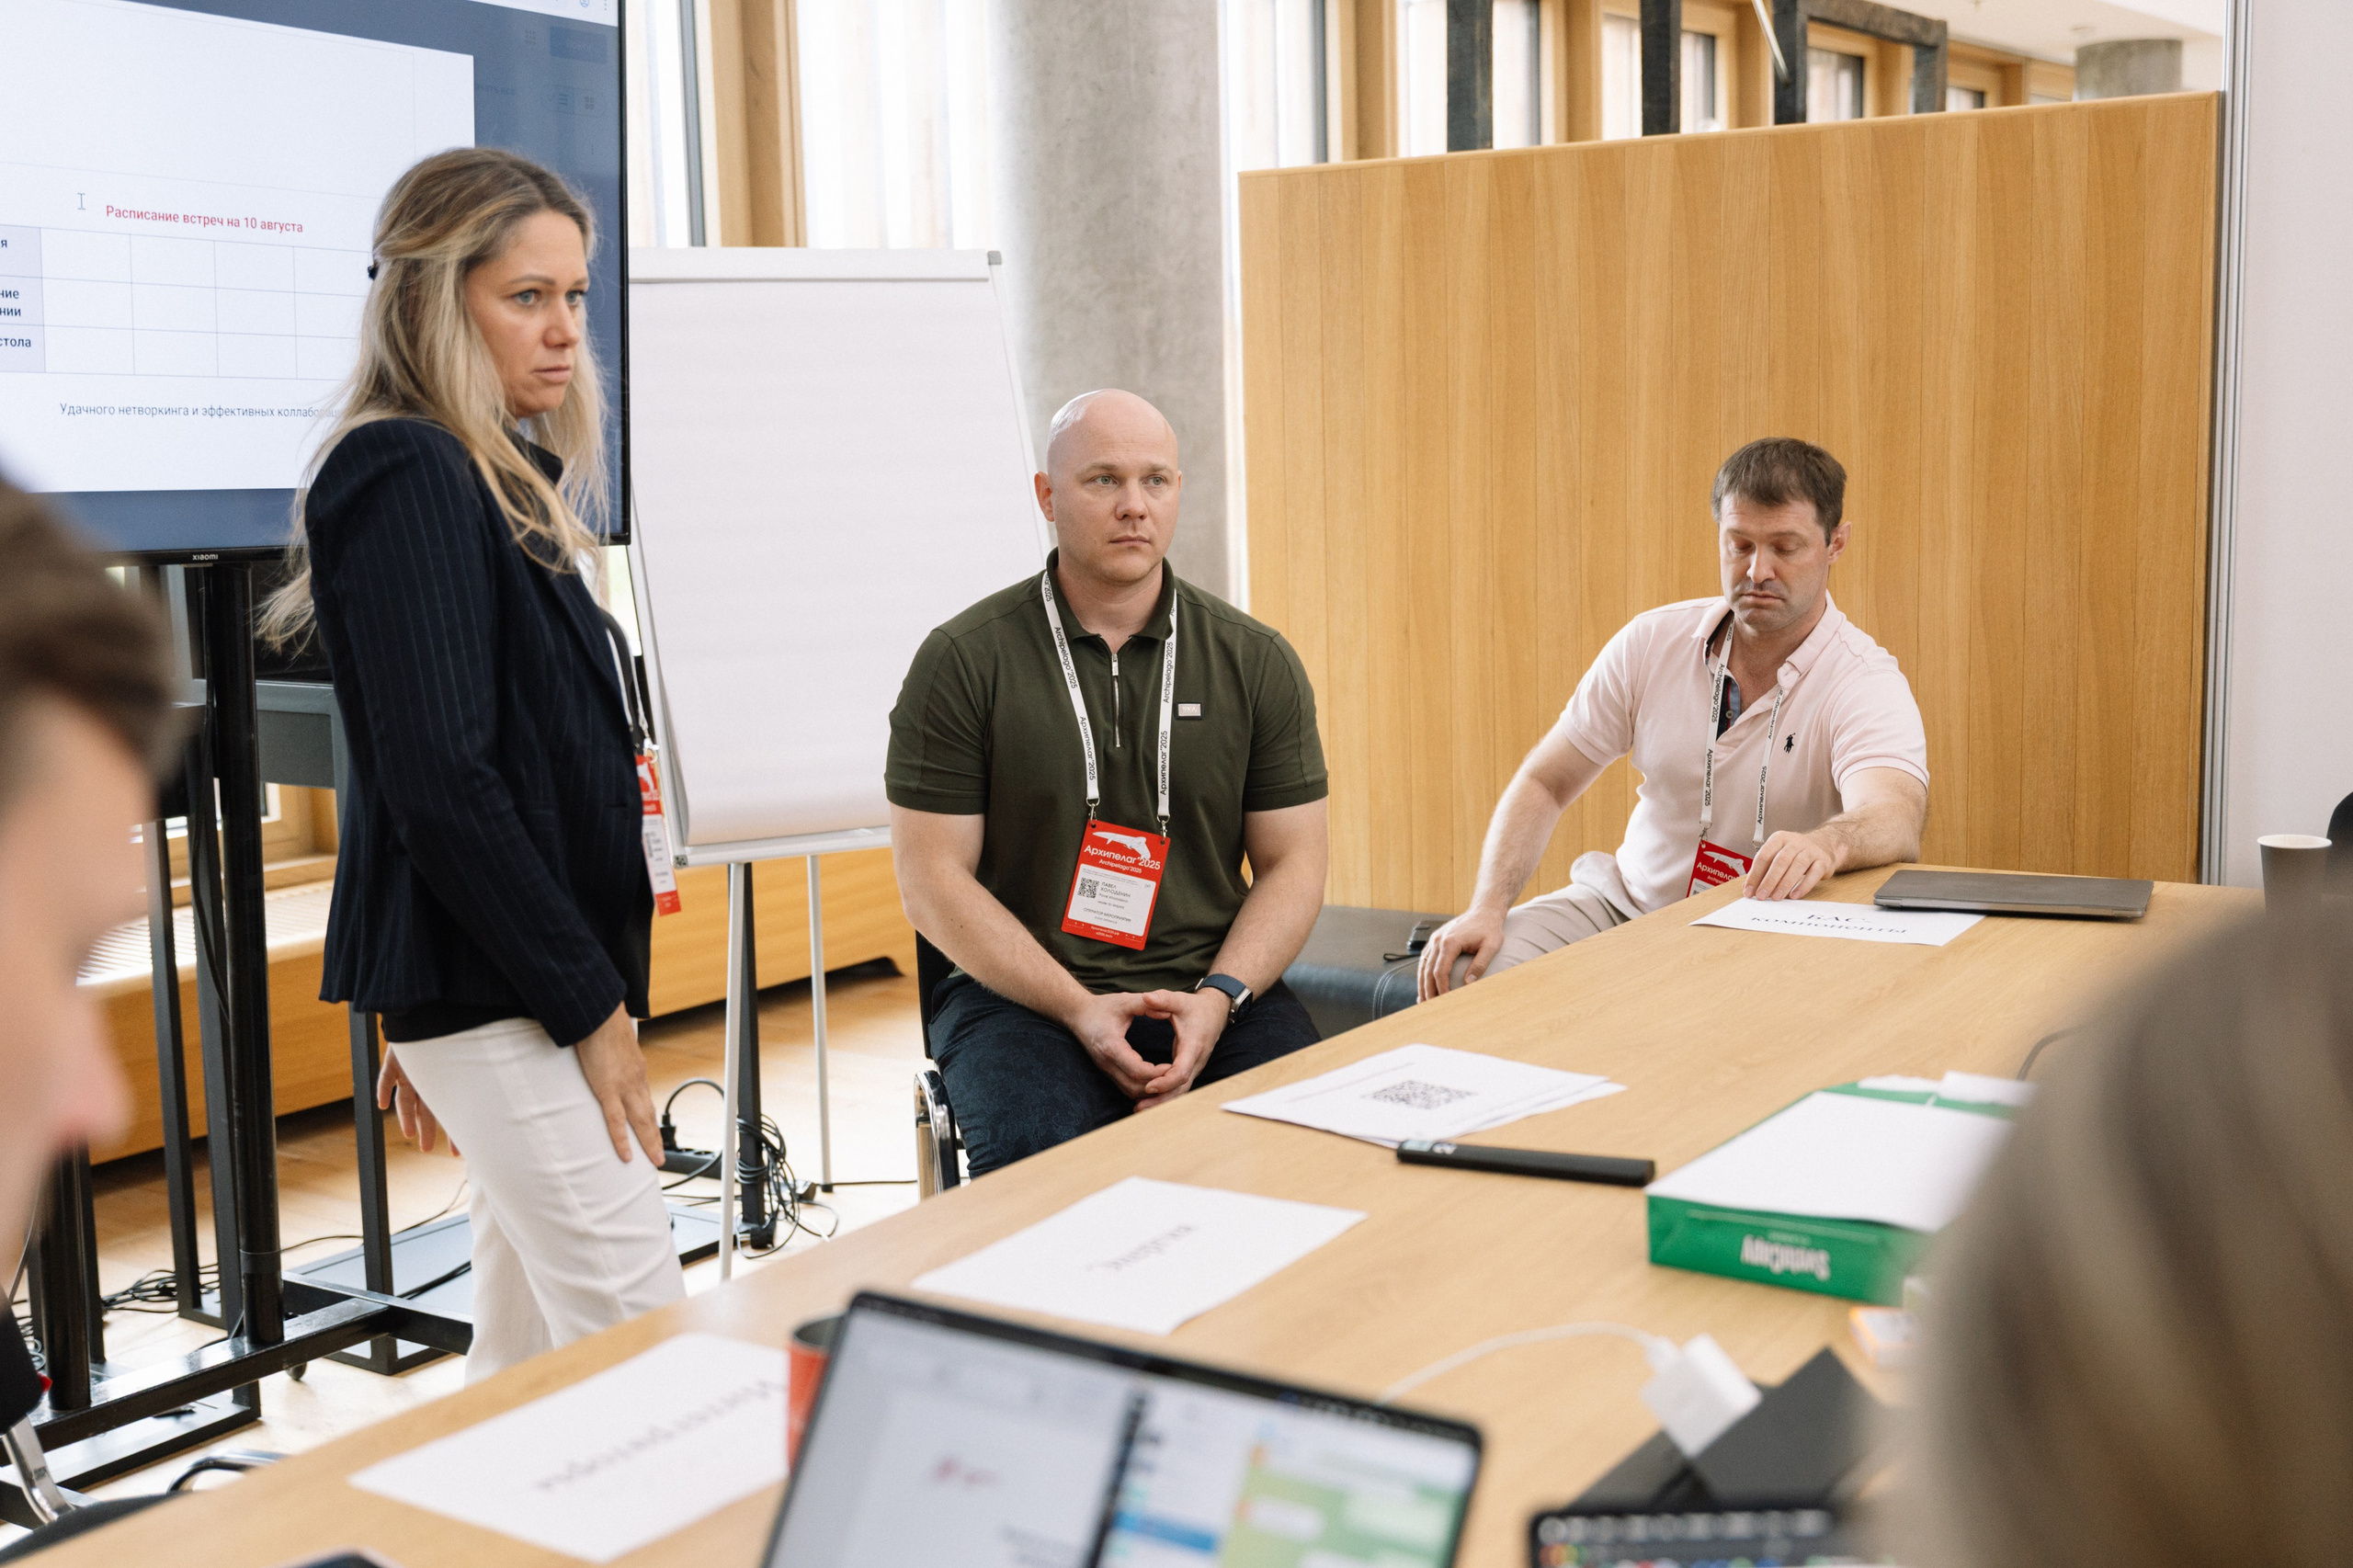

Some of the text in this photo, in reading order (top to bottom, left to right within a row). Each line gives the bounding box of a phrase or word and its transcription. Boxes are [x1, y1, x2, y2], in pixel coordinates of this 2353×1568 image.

[106, 205, 304, 233] Расписание встреч на 10 августа
[60, 402, 116, 416] Удачного
[118, 405, 189, 417] нетворкинга
[191, 407, 199, 416] и
[201, 405, 275, 419] эффективных
[1084, 845, 1161, 870] Архипелаг'2025
